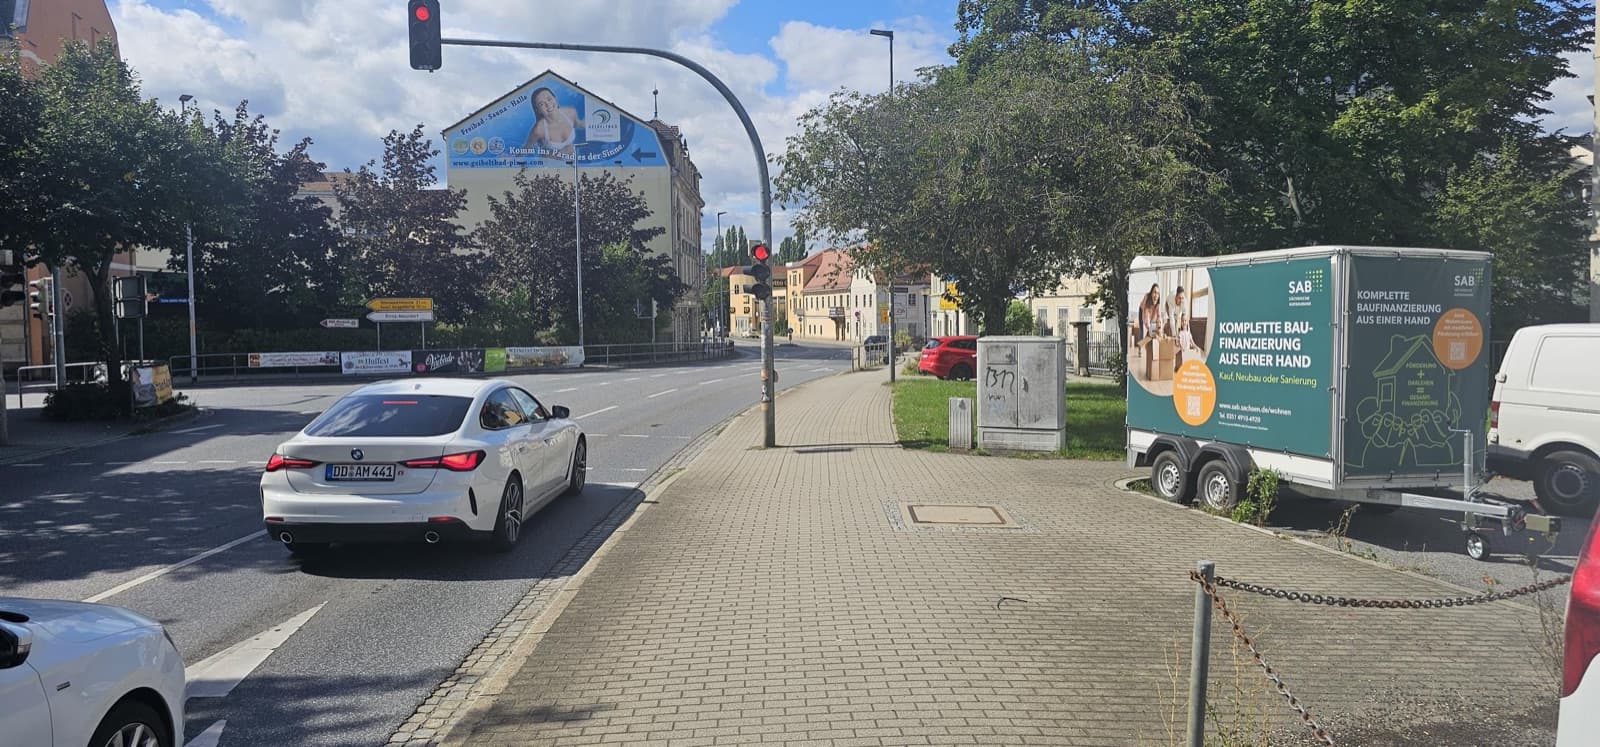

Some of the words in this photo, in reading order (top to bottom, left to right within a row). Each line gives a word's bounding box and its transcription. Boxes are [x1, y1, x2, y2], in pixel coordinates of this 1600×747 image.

[461, 118, 484, 135] Freibad
[488, 106, 507, 120] Sauna
[510, 95, 528, 108] Halle
[552, 148, 586, 160] Parades
[1289, 280, 1312, 294] SAB
[1454, 276, 1475, 286] SAB
[1357, 290, 1410, 300] KOMPLETTE
[1357, 303, 1441, 313] BAUFINANZIERUNG
[1356, 316, 1374, 324] AUS
[1377, 316, 1402, 325] EINER
[1404, 316, 1430, 325] HAND
[1220, 322, 1282, 334] KOMPLETTE
[1284, 321, 1313, 334] BAU-
[1220, 338, 1301, 350] FINANZIERUNG
[1219, 353, 1239, 365] AUS
[1242, 354, 1273, 366] EINER
[1276, 355, 1311, 368] HAND
[1220, 371, 1233, 380] Kauf,
[1236, 372, 1261, 382] Neubau
[1263, 374, 1279, 383] oder
[1280, 375, 1317, 388] Sanierung
[1219, 403, 1292, 416] www.sab.sachsen.de/wohnen
[334, 466, 348, 477] DD
[355, 466, 370, 477] AM
[372, 466, 392, 477] 441
